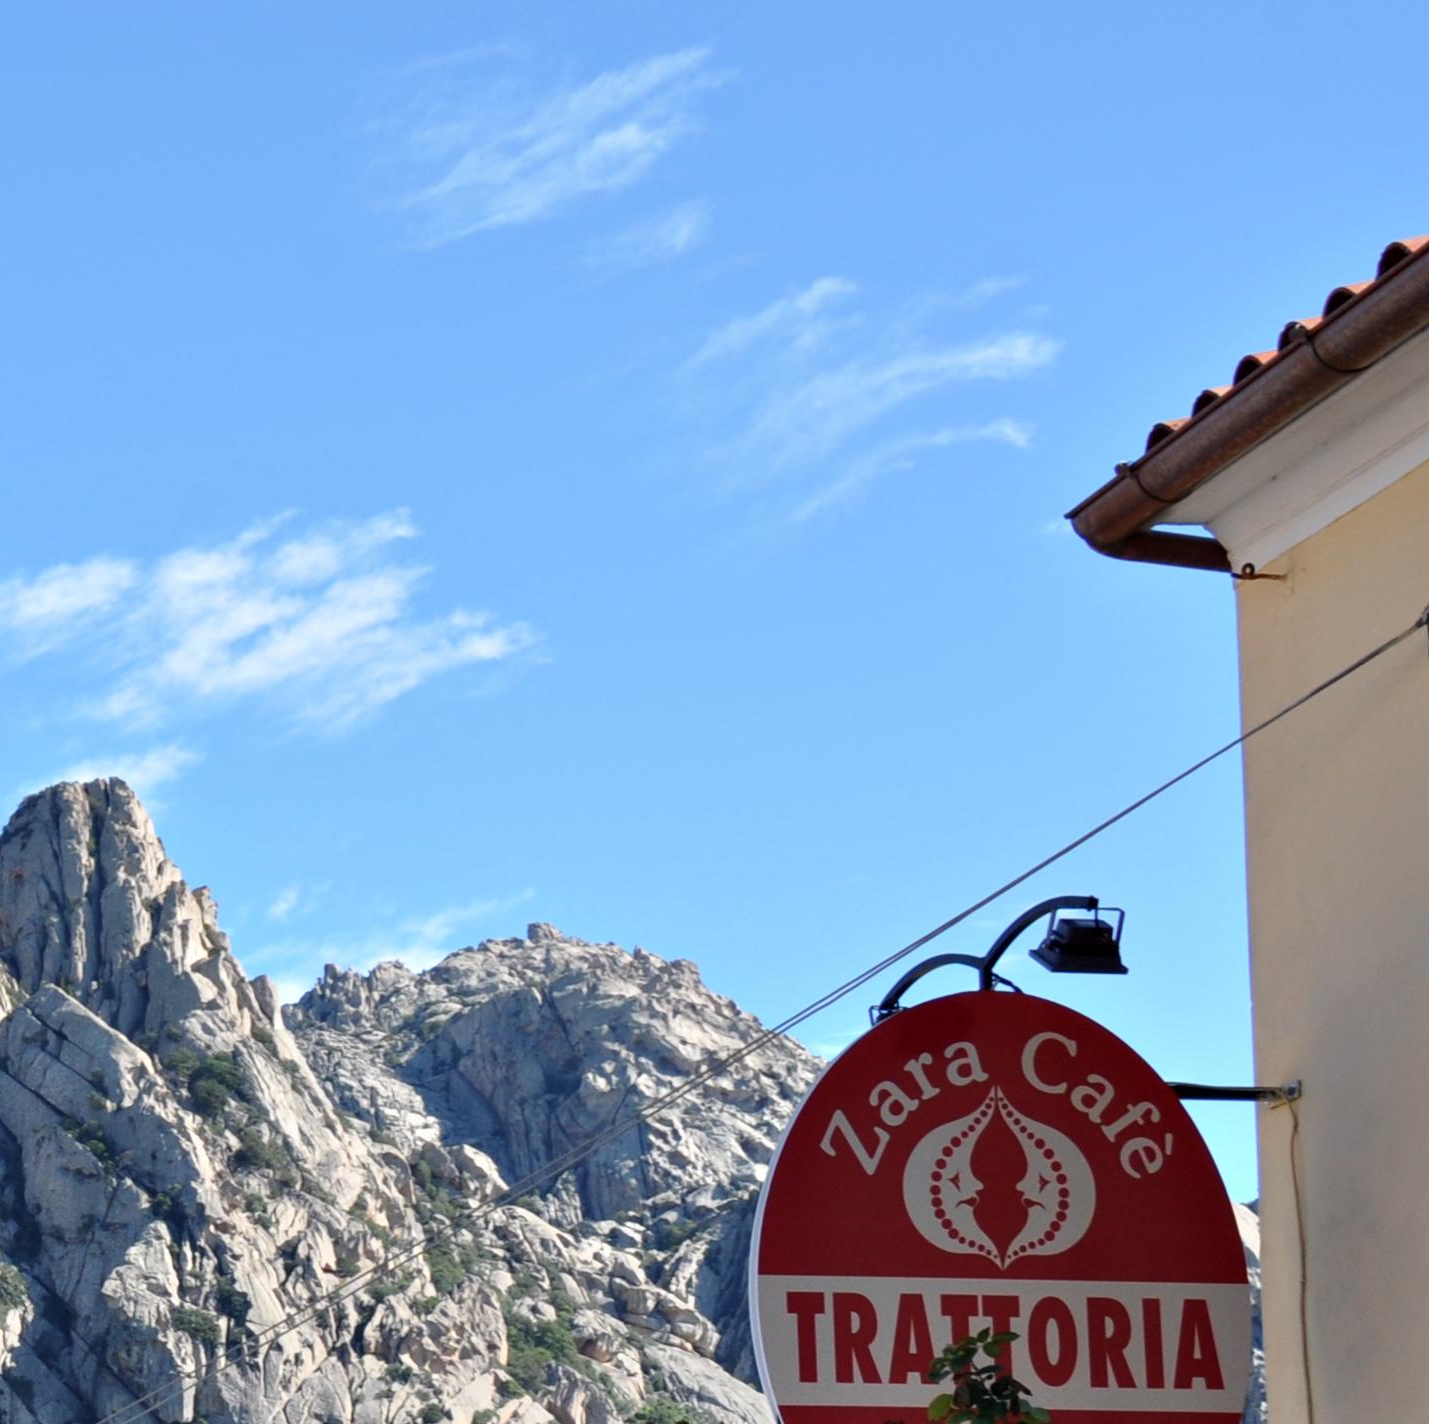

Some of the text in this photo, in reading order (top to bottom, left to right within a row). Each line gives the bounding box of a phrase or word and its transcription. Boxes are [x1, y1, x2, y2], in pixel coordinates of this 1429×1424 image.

[820, 1031, 1174, 1179] Zara Café
[785, 1291, 1226, 1391] TRATTORIA
